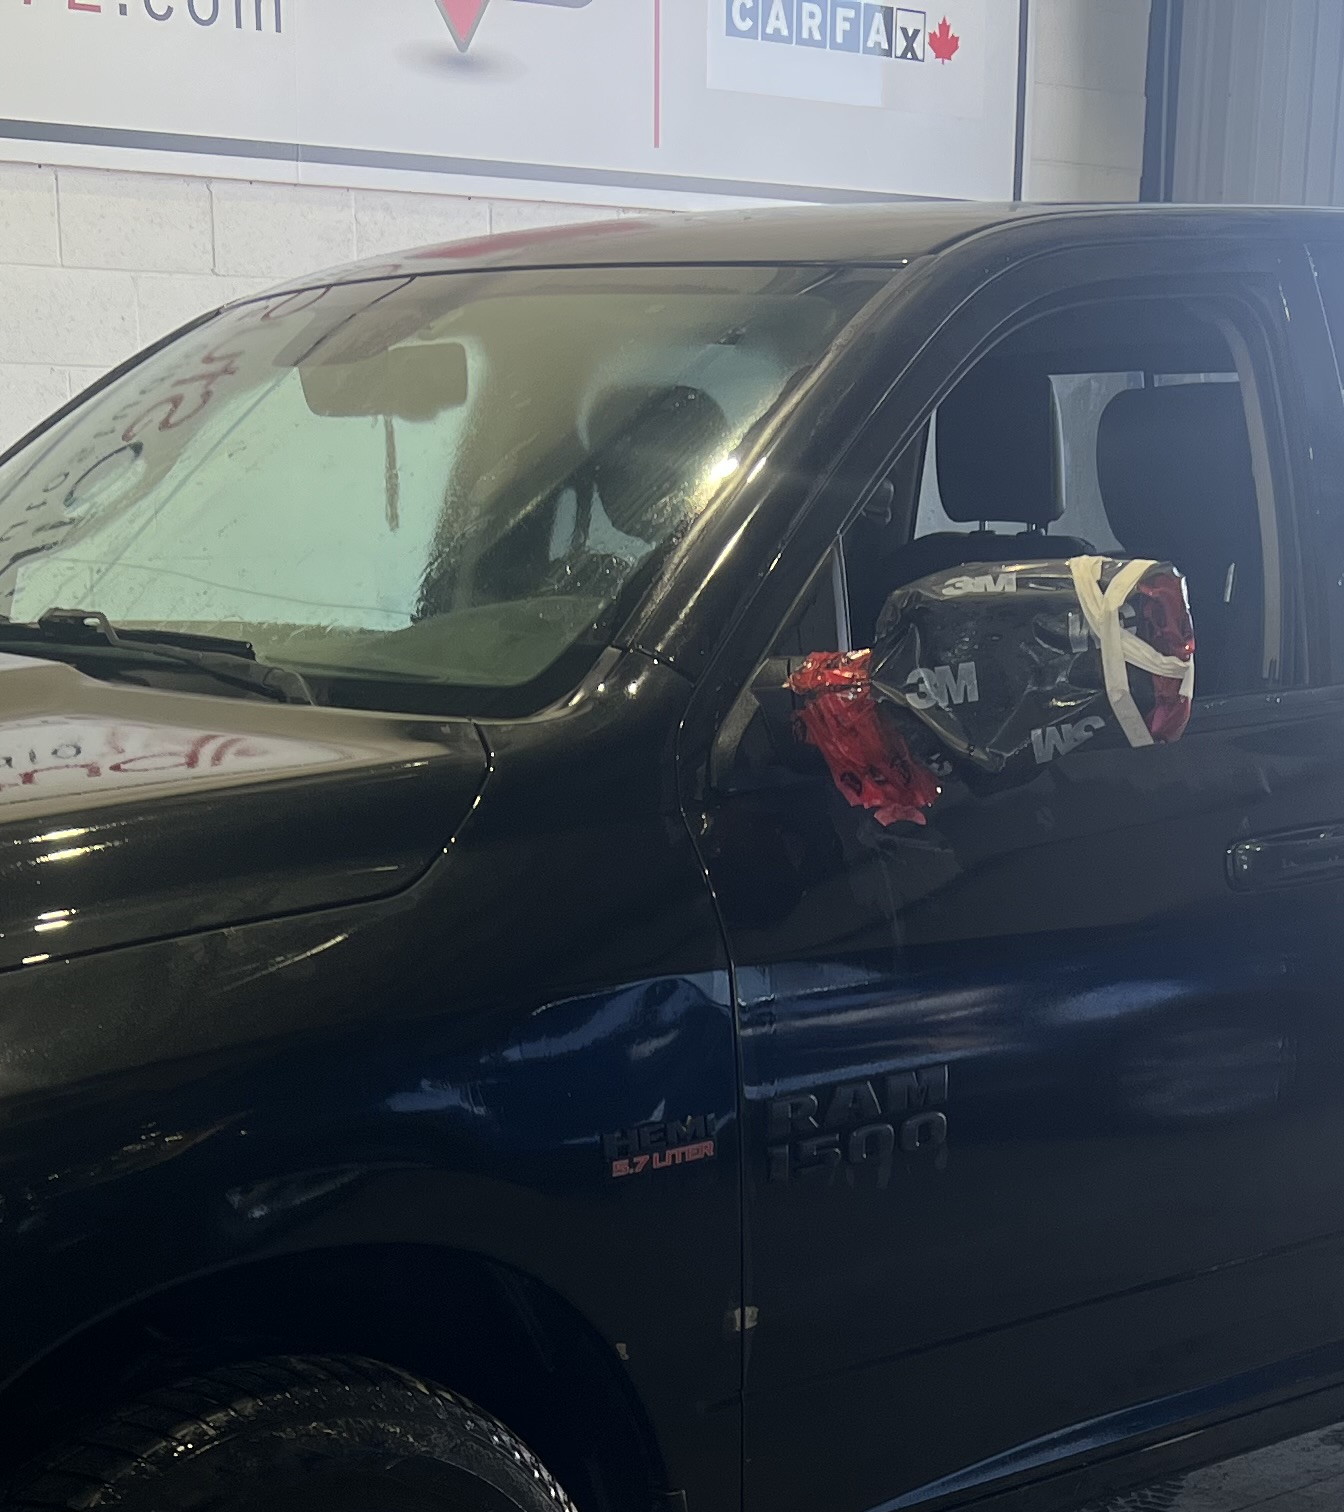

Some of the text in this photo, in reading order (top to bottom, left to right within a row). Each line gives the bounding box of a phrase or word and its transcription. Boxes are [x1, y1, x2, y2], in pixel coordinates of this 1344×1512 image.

[24, 0, 281, 33] .com
[731, 0, 922, 61] CARFAX
[941, 571, 1017, 597] 3M
[906, 661, 980, 710] 3M
[766, 1063, 949, 1136] RAM
[601, 1113, 715, 1158] HEMI
[611, 1140, 715, 1178] 5.7 LITER
[766, 1111, 949, 1178] 1500
